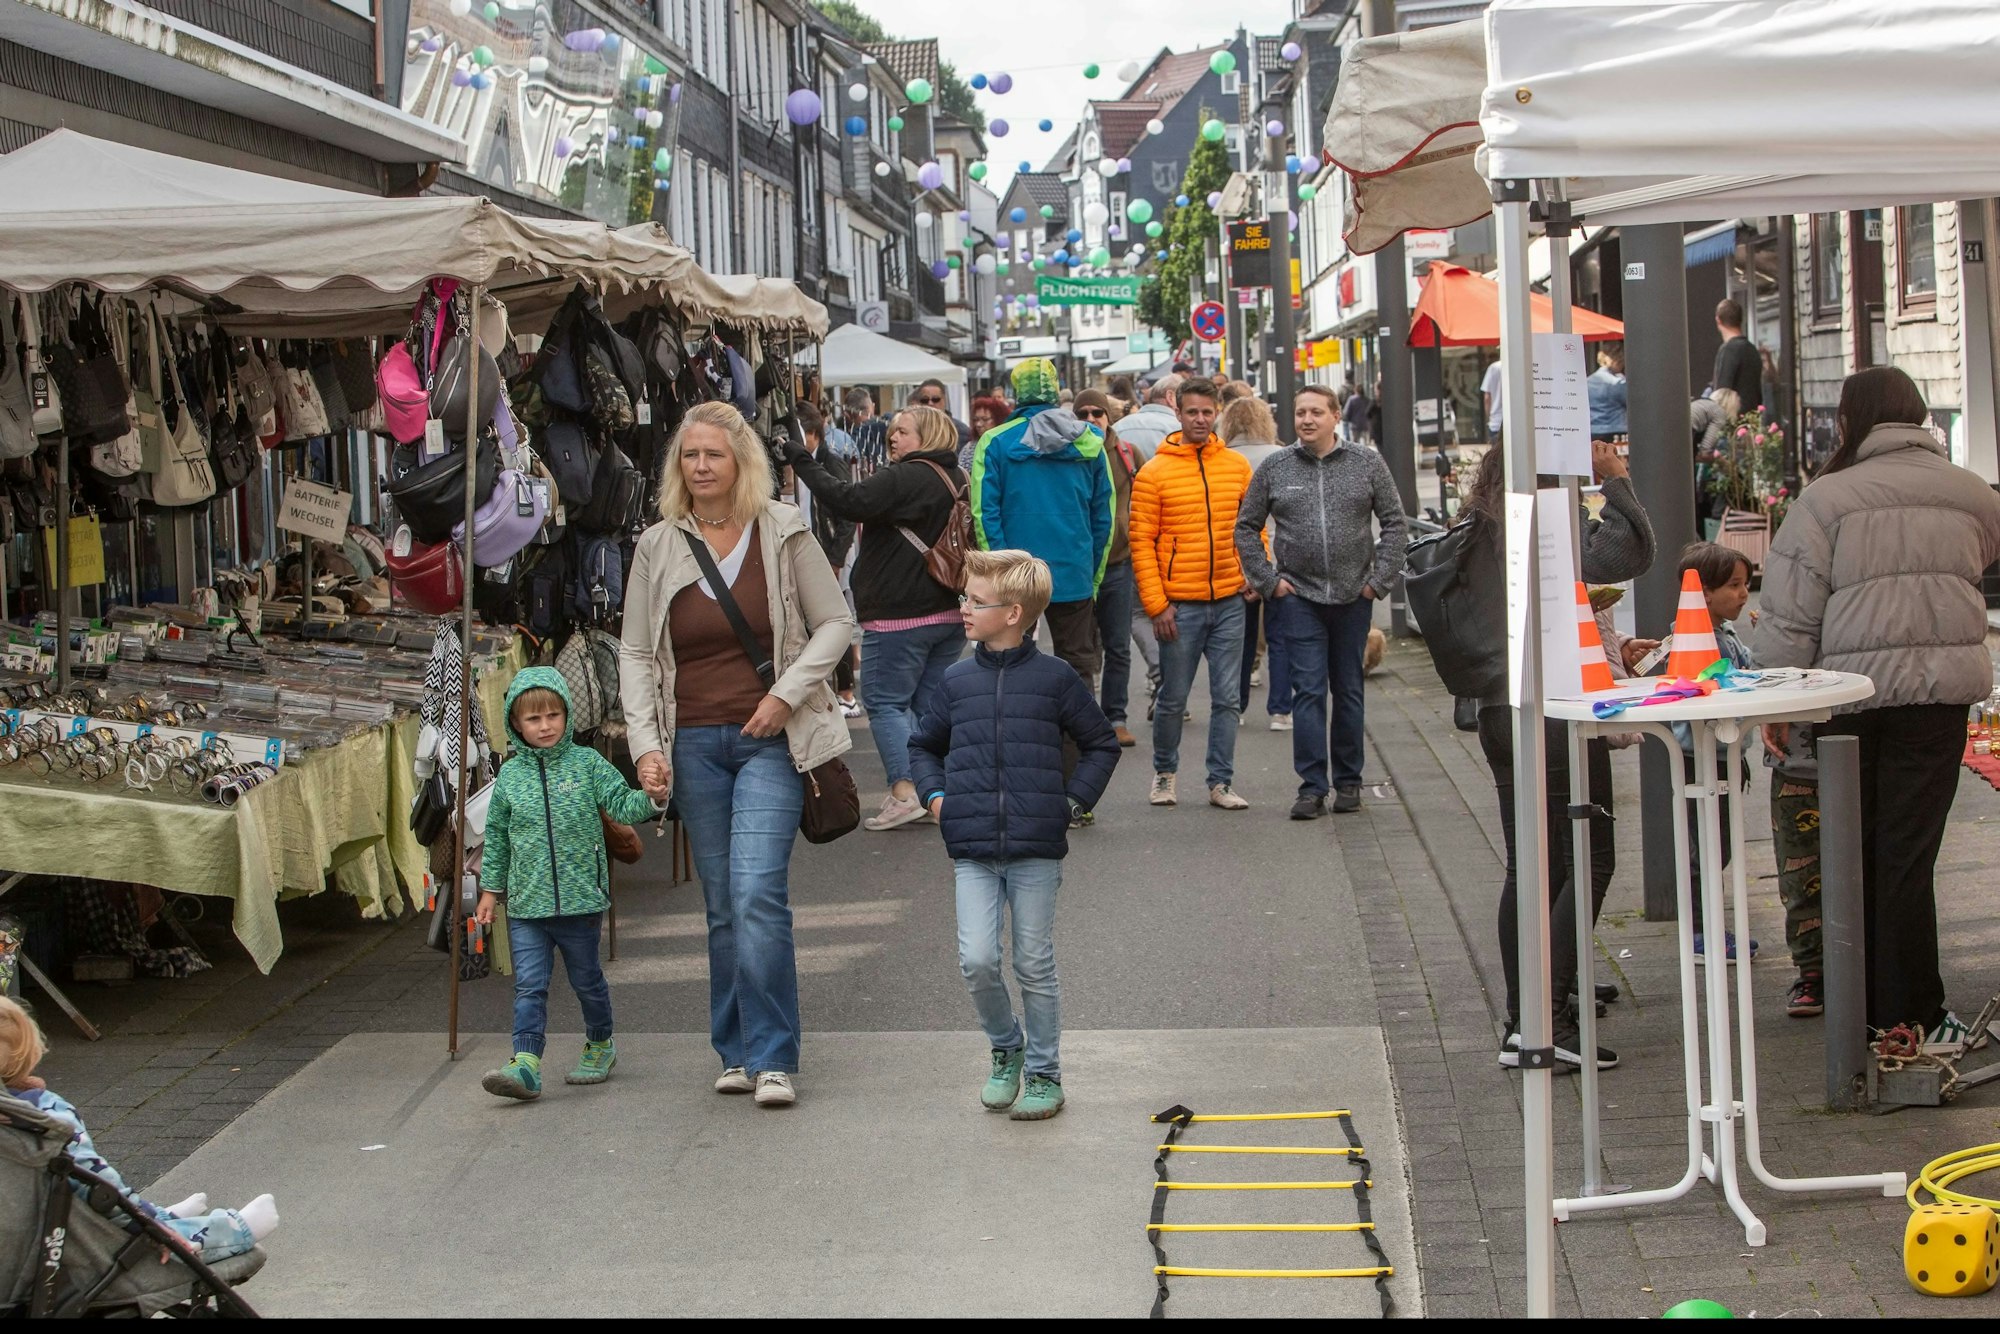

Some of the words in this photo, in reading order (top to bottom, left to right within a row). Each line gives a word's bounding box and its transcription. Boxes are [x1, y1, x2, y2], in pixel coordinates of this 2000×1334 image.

[1245, 226, 1263, 238] SIE
[1964, 244, 1980, 261] 41
[1040, 284, 1132, 298] FLUCHTWEG
[294, 488, 341, 511] BATTERIE
[290, 506, 335, 529] WECHSEL
